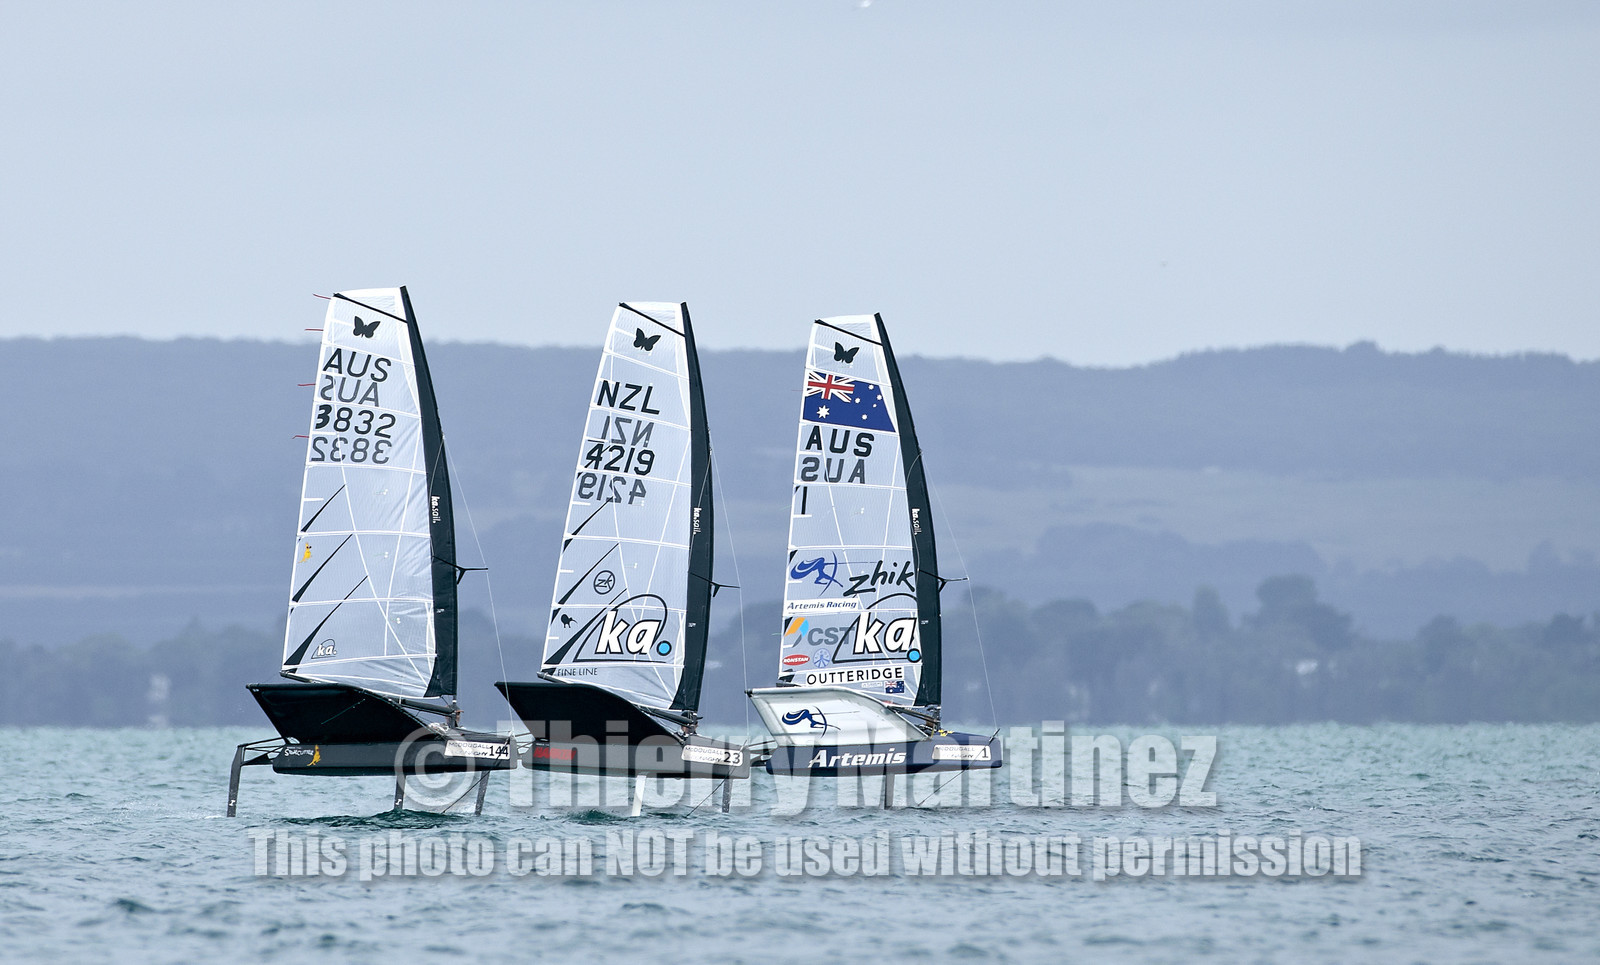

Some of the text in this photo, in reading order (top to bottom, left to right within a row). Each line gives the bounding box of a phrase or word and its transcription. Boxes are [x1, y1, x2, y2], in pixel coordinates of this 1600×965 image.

[323, 348, 391, 382] AUS
[597, 380, 660, 415] NZL
[315, 404, 396, 438] 3832
[806, 425, 874, 457] AUS
[585, 443, 655, 476] 4219
[843, 560, 915, 596] zhik
[807, 626, 855, 646] CST
[557, 667, 598, 676] FINE LINE
[806, 667, 903, 685] OUTTERIDGE
[724, 751, 740, 764] 23
[808, 748, 906, 768] Artemis
[982, 747, 988, 758] 1
